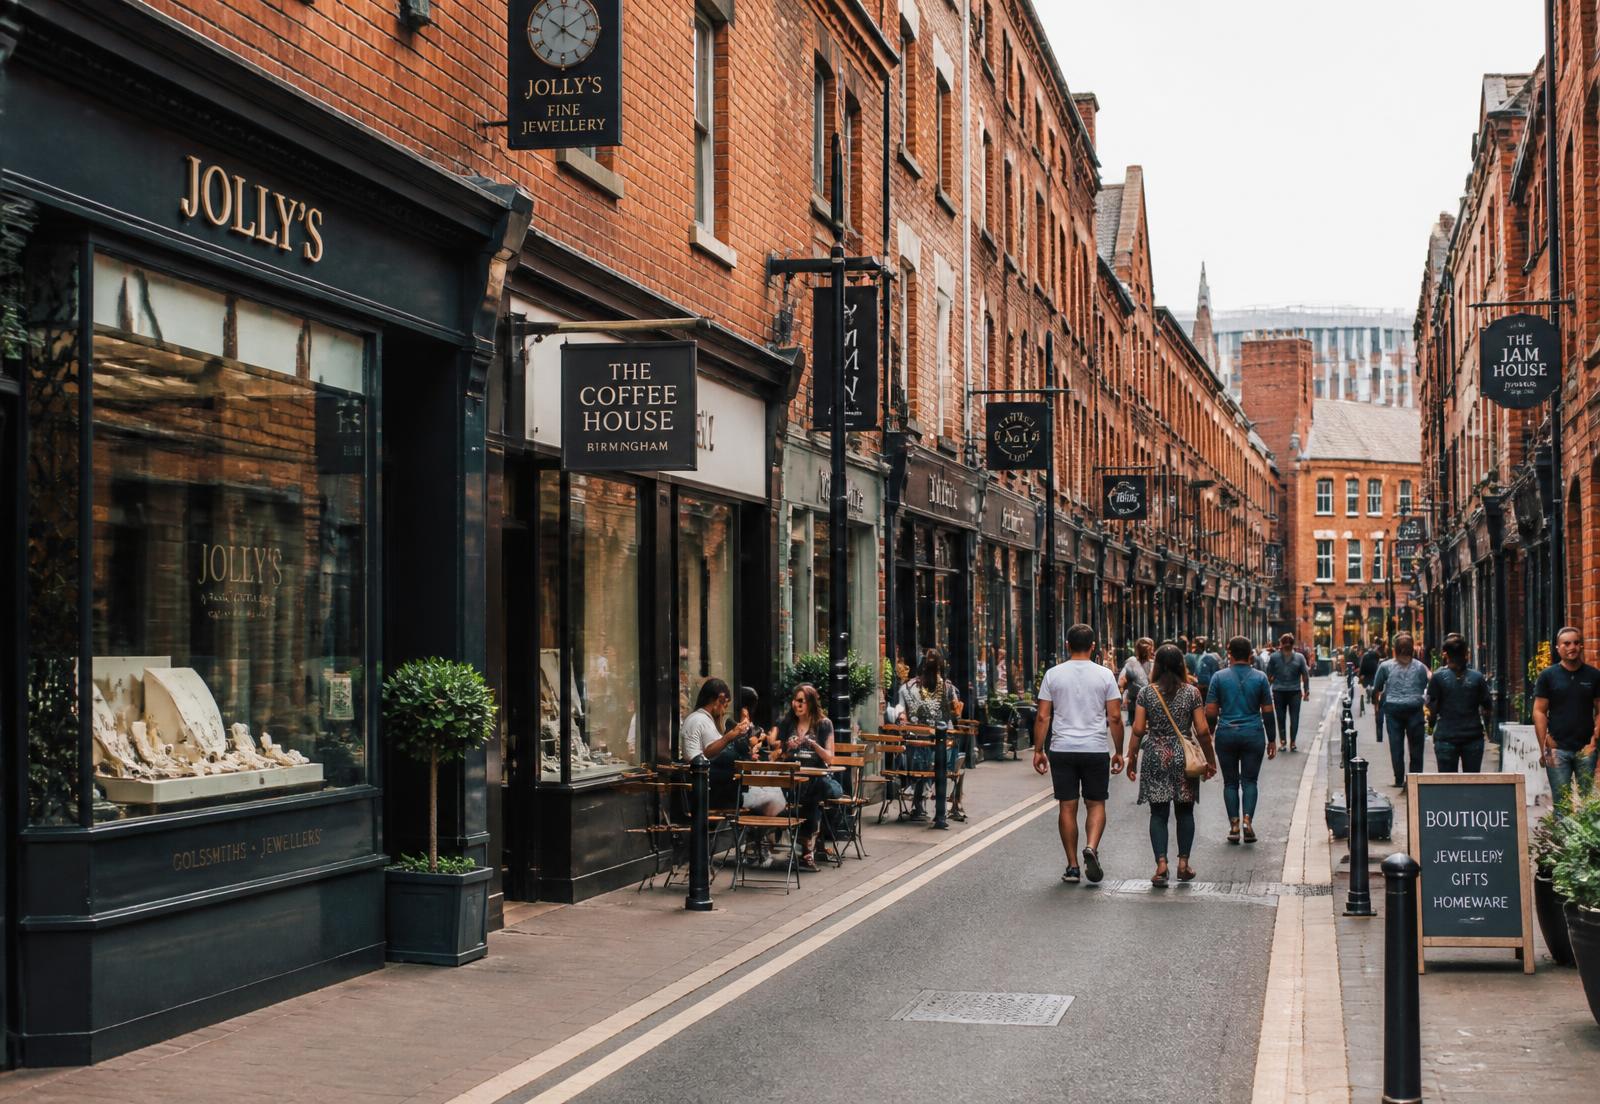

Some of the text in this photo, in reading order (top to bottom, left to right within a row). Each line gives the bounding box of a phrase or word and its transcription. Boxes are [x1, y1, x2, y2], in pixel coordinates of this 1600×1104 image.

[524, 76, 603, 99] JOLLY'S
[547, 103, 581, 117] FINE
[521, 118, 607, 135] JEWELLERY
[180, 155, 324, 263] JOLLY'S
[1507, 333, 1533, 346] THE
[1501, 347, 1539, 363] JAM
[608, 362, 652, 381] THE
[1493, 363, 1548, 378] HOUSE
[579, 385, 678, 407] COFFEE
[583, 410, 675, 432] HOUSE
[197, 543, 283, 586] JOLLY'S
[1426, 810, 1510, 832] BOUTIQUE
[1451, 872, 1489, 886] GIFTS
[1433, 896, 1509, 909] HOMEWARE
